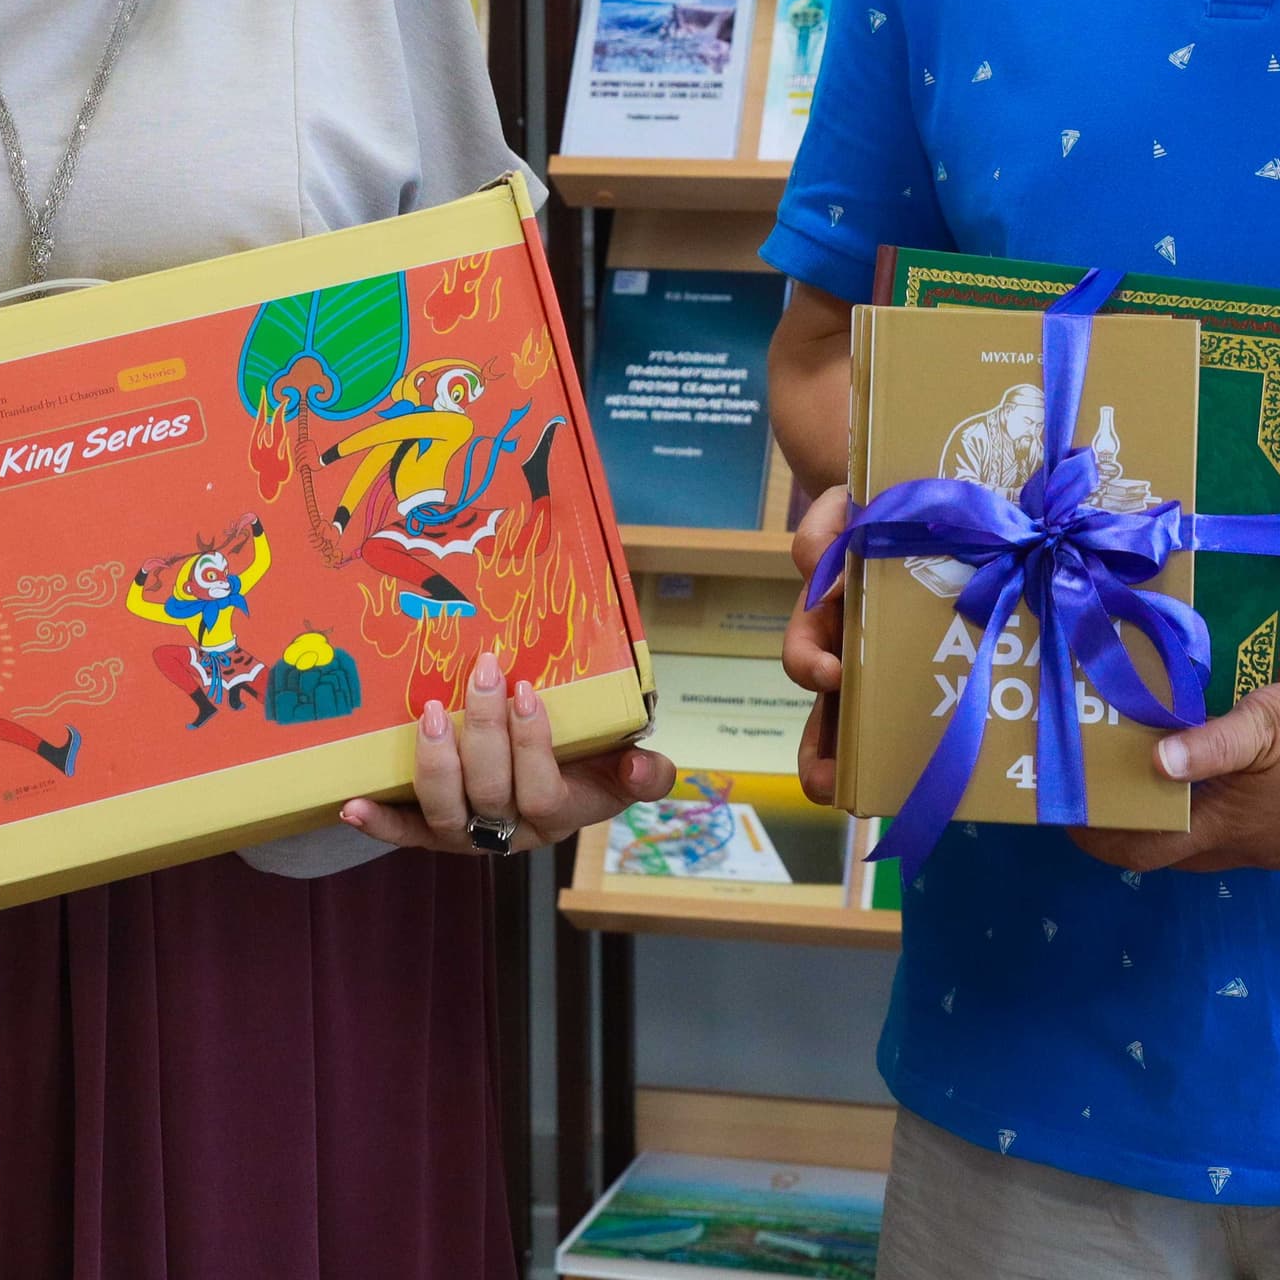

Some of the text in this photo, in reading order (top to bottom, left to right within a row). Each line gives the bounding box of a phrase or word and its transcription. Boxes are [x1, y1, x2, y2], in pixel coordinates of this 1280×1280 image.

[127, 367, 177, 385] 32 Stories
[0, 385, 115, 419] Translated by Li Chaoyuan
[0, 440, 74, 480] King
[82, 415, 191, 459] Series
[931, 674, 1120, 725] ЖОЫ
[1006, 755, 1038, 789] 4
